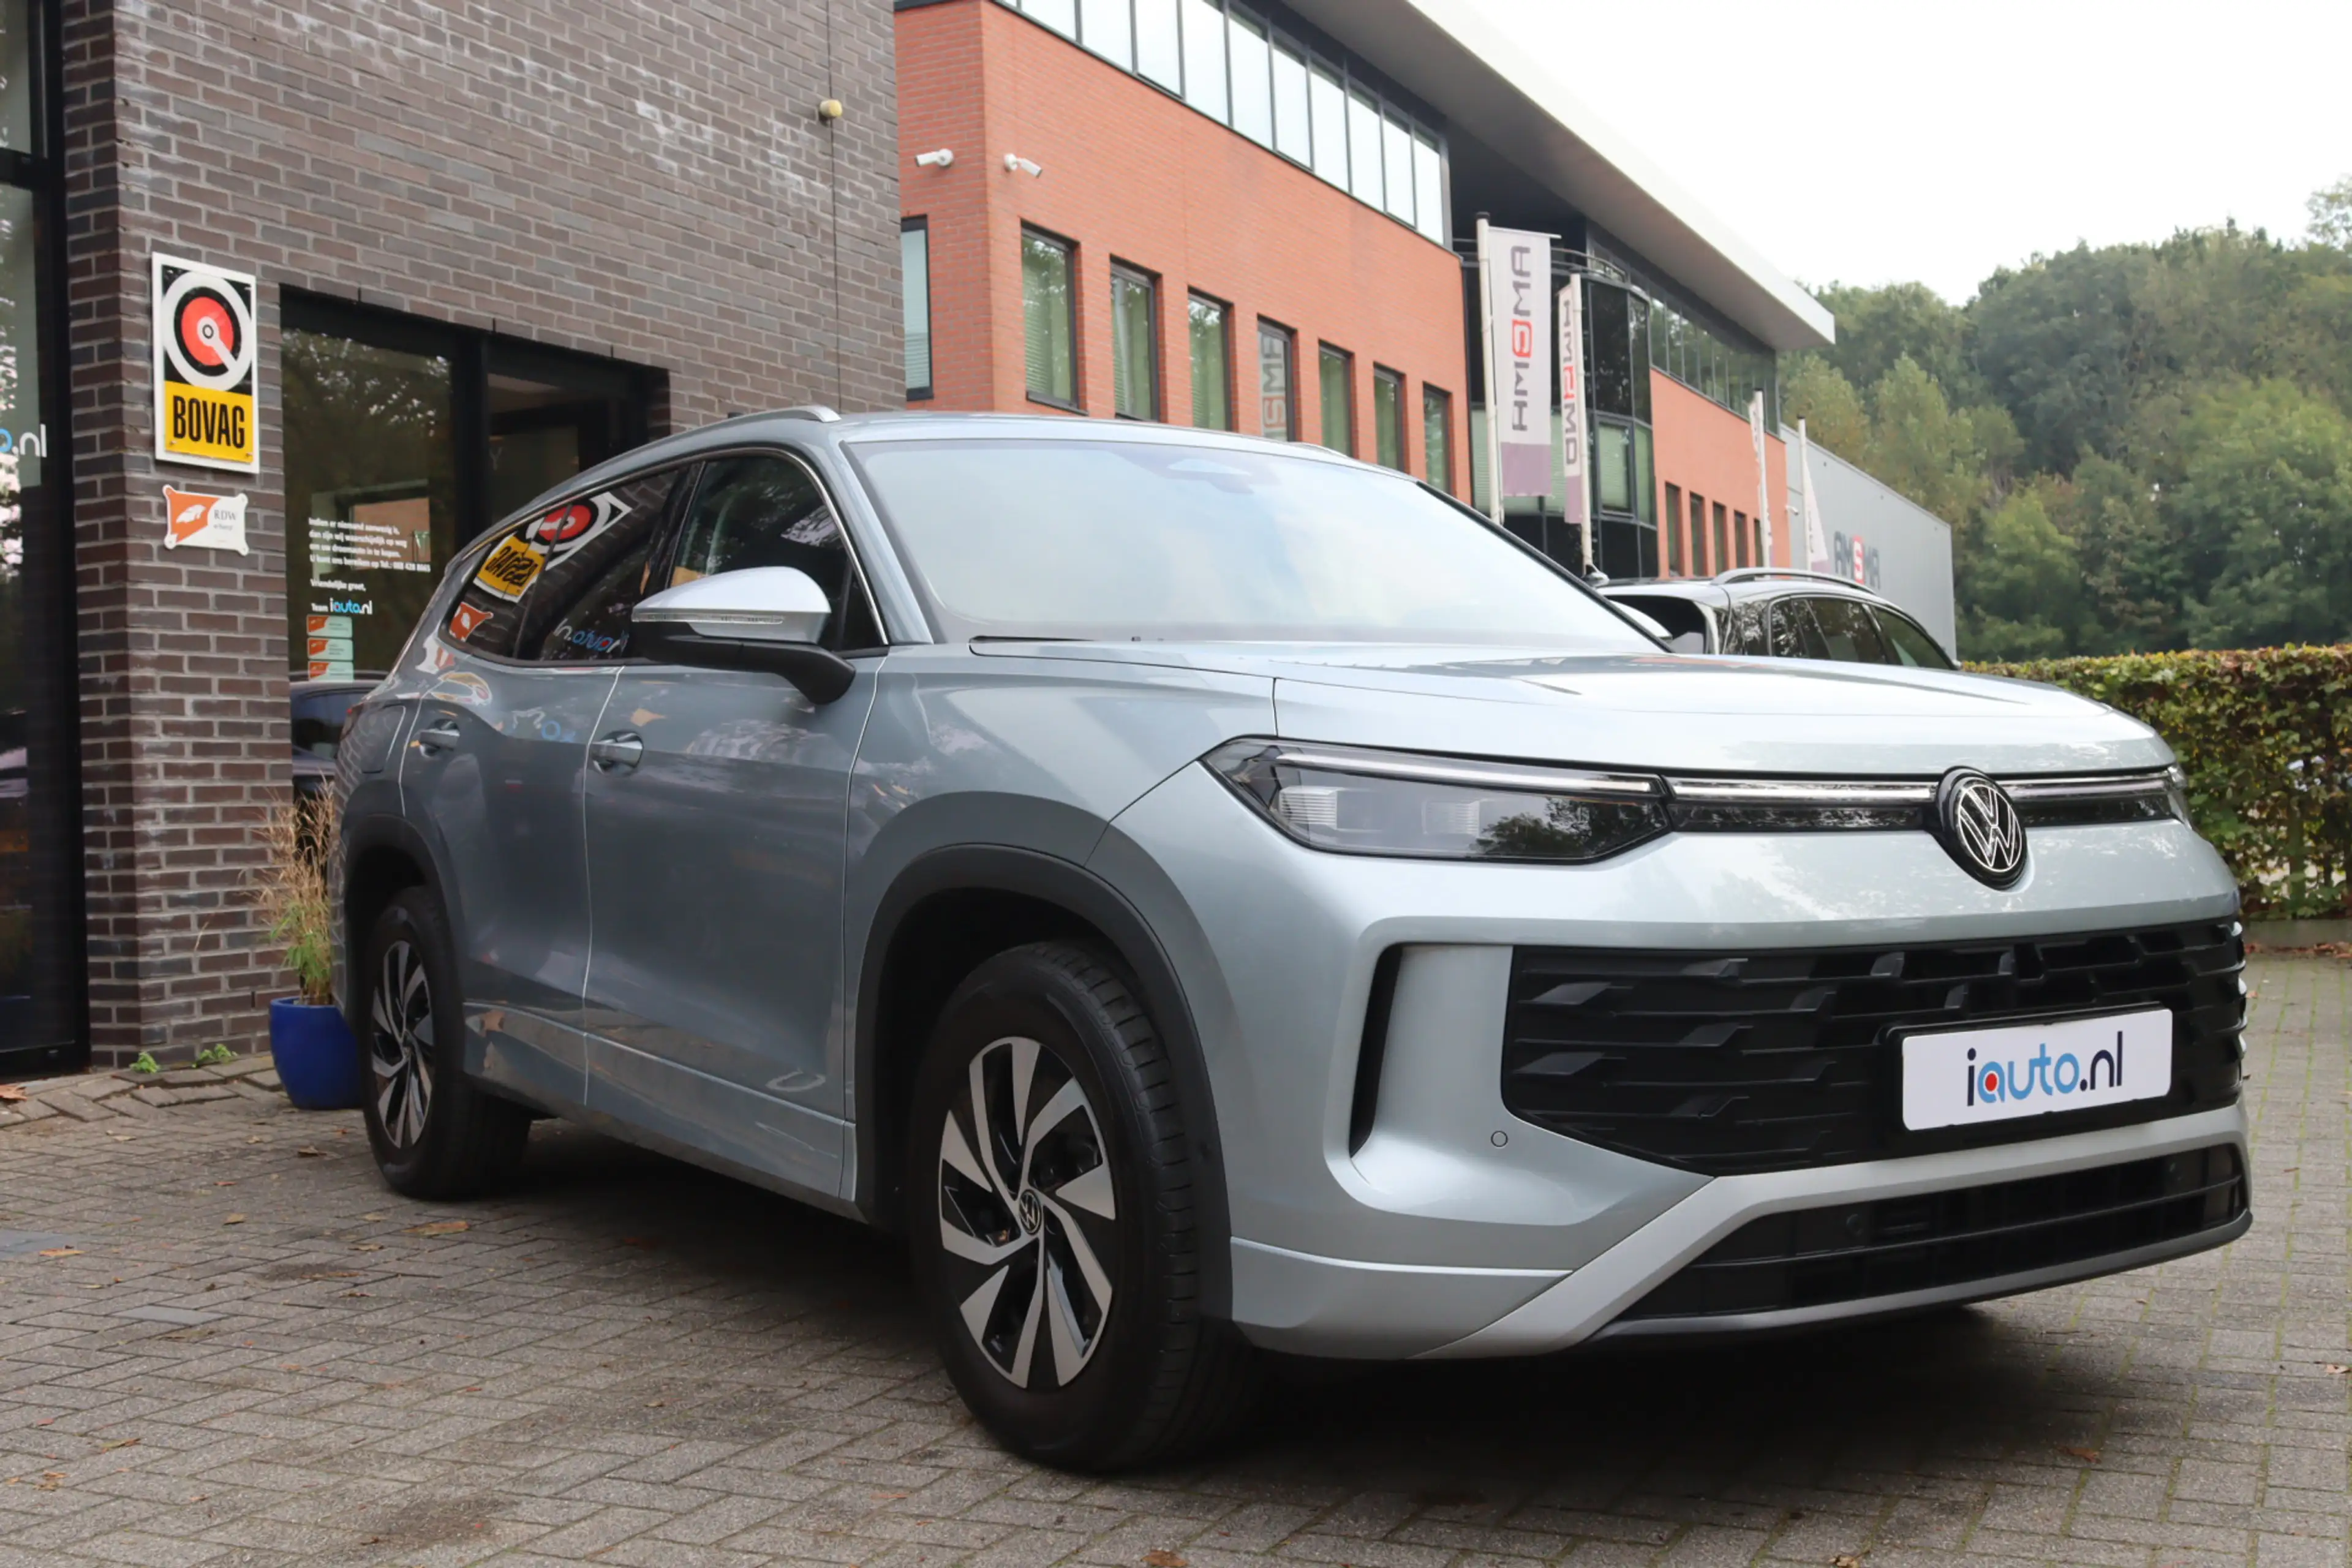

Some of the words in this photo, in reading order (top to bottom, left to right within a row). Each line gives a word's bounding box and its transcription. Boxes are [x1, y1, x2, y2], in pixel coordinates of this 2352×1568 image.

[172, 395, 245, 449] BOVAG
[330, 596, 373, 615] iauto.nl
[1967, 1030, 2123, 1106] iauto.nl
